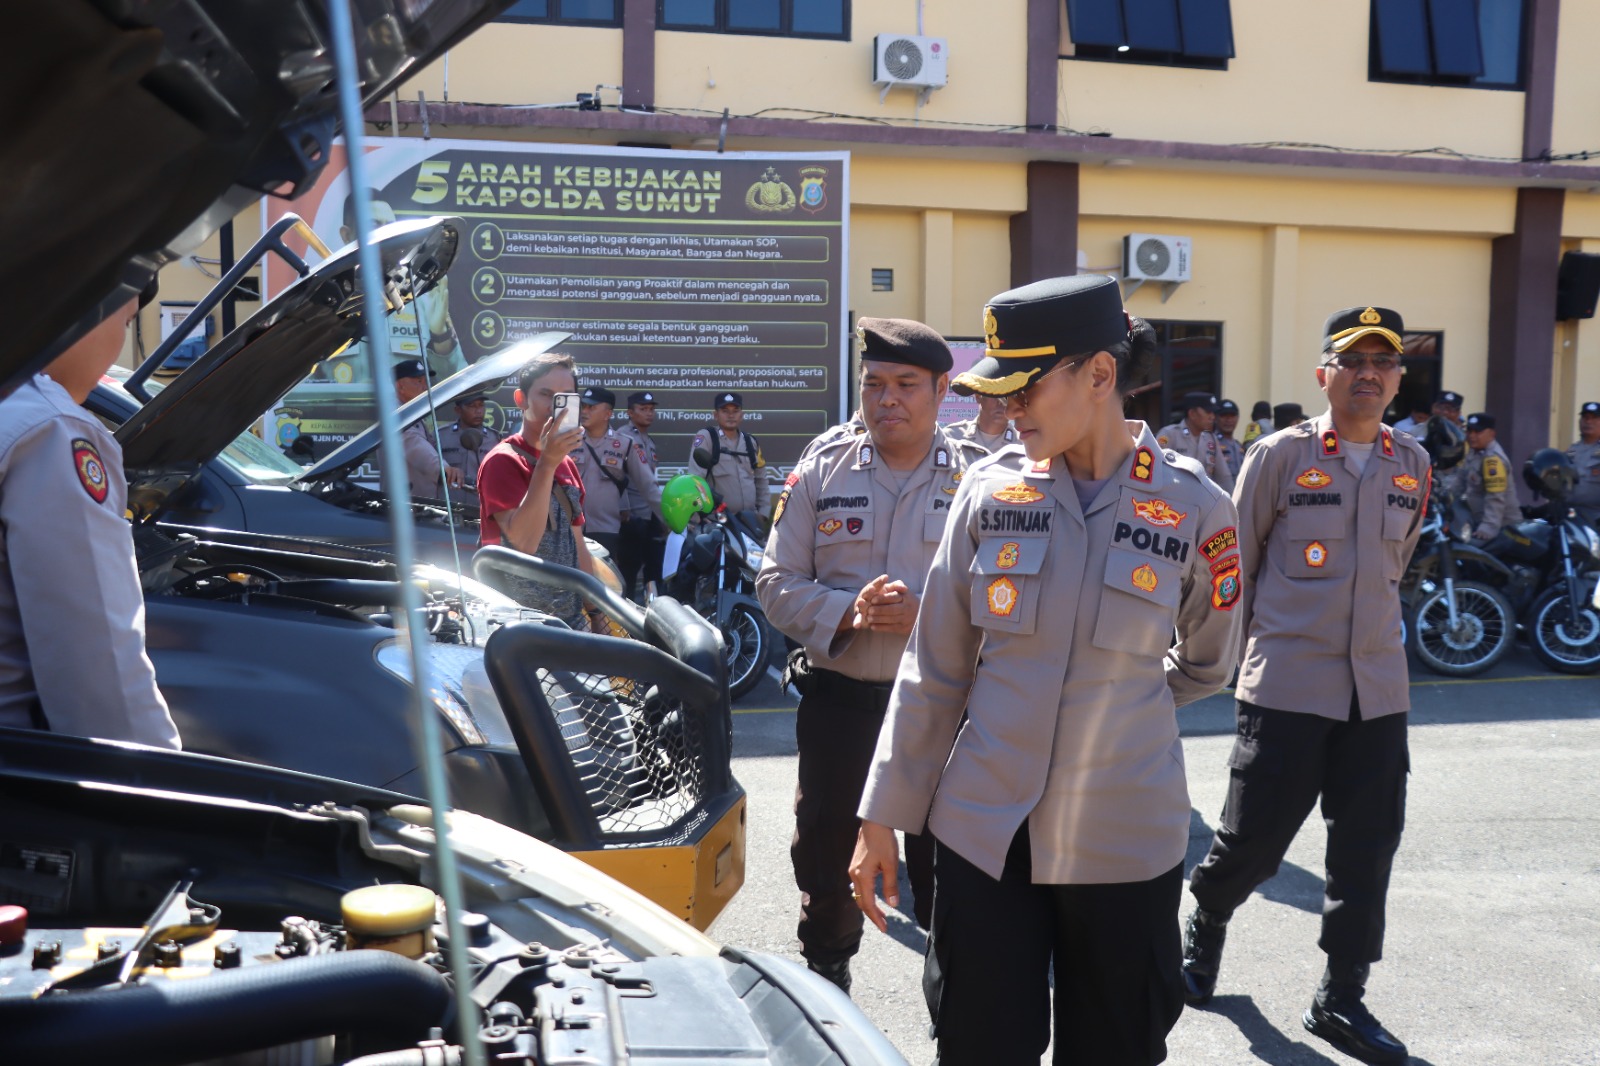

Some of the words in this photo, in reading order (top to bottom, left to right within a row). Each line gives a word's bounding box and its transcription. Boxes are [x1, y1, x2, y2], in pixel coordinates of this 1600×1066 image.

[411, 161, 451, 205] 5
[457, 162, 541, 185] ARAH
[554, 165, 721, 191] KEBIJAKAN
[456, 184, 605, 211] KAPOLDA
[616, 190, 721, 213] SUMUT
[480, 230, 494, 250] 1
[506, 232, 566, 242] Laksanakan
[568, 233, 598, 244] setiap
[600, 234, 628, 245] tugas
[630, 235, 668, 247] dengan
[703, 237, 753, 247] Utamakan
[756, 238, 779, 248] SOP,
[506, 243, 532, 253] demi
[534, 244, 579, 254] kebaikan
[582, 245, 624, 256] Institusi,
[626, 246, 684, 258] Masyarakat,
[686, 249, 722, 259] Bangsa
[724, 249, 743, 258] dan
[746, 250, 783, 260] Negara.
[480, 274, 495, 294] 2
[507, 276, 558, 285] Utamakan
[561, 277, 615, 287] Pemolisian
[617, 279, 641, 290] yang
[644, 279, 683, 289] Proaktif
[685, 279, 715, 290] dalam
[718, 281, 769, 292] mencegah
[771, 281, 790, 290] dan
[506, 288, 559, 299] mengatasi
[562, 289, 598, 299] potensi
[601, 290, 654, 301] gangguan,
[656, 291, 698, 301] sebelum
[700, 292, 740, 302] menjadi
[742, 293, 791, 304] gangguan
[794, 294, 823, 303] nyata.
[480, 317, 495, 337] 3
[506, 319, 544, 330] Jangan
[546, 320, 579, 330] undser
[582, 321, 626, 331] estimate
[628, 322, 659, 333] segala
[662, 322, 697, 333] bentuk
[699, 323, 749, 334] gangguan
[571, 332, 608, 341] akukan
[610, 333, 640, 342] sesuai
[643, 334, 693, 344] ketentuan
[695, 335, 719, 345] yang
[721, 335, 760, 344] berlaku.
[577, 366, 607, 376] gakan
[610, 366, 645, 375] hukum
[647, 367, 678, 376] secara
[681, 367, 737, 378] profesional,
[739, 367, 797, 379] proposional,
[799, 368, 823, 377] serta
[577, 377, 602, 386] dilan
[604, 378, 633, 387] untuk
[636, 378, 703, 389] mendapatkan
[706, 378, 769, 388] kemanfaatan
[772, 379, 808, 389] hukum.
[483, 408, 495, 428] 5
[657, 411, 676, 421] TNI,
[678, 412, 715, 422] Forkopi
[743, 413, 763, 421] erta
[980, 509, 1051, 533] S.SITINJAK
[1113, 521, 1190, 563] POLRI
[1207, 530, 1234, 551] POLRES
